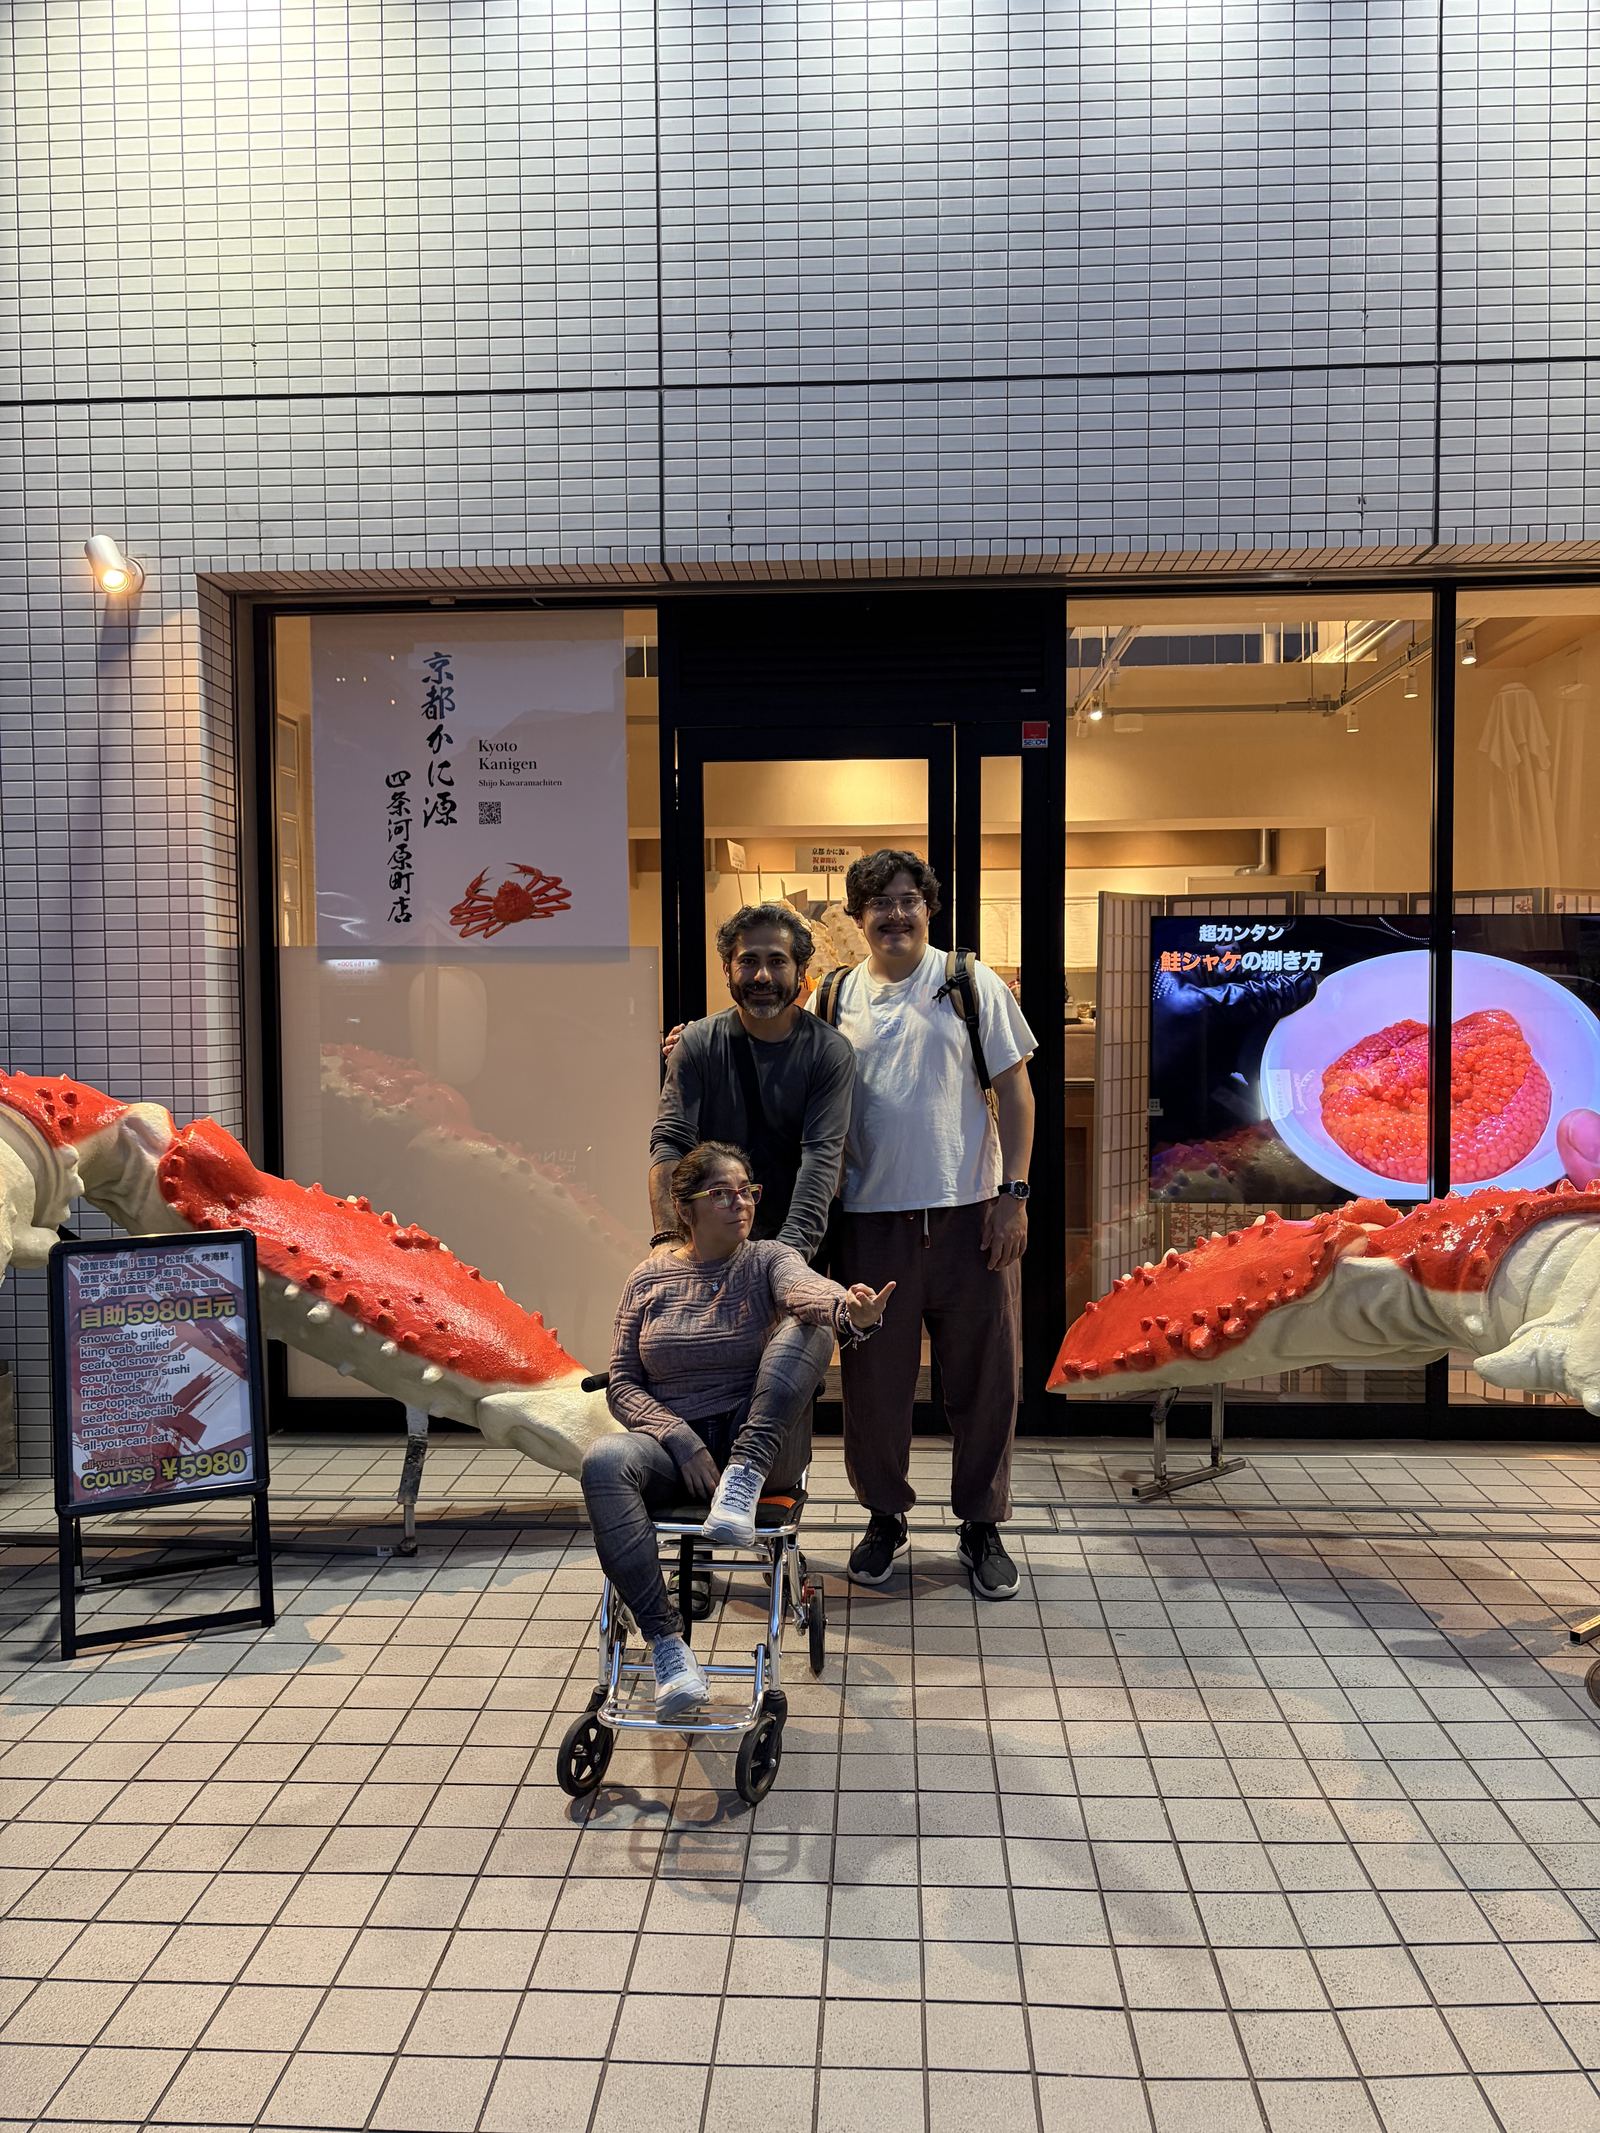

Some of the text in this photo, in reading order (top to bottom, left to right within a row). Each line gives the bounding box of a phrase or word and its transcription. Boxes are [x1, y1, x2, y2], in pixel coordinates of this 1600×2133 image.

[421, 651, 458, 829] 京都かに源
[478, 740, 518, 756] Kyoto
[478, 757, 537, 774] Kanigen
[478, 779, 563, 788] Shijo Kawaramachiten
[385, 770, 414, 923] 四条河原町店
[1199, 924, 1284, 943] 超カンタン
[1160, 950, 1323, 972] 鮭シャケの捌き方
[81, 1296, 236, 1328] 自助5980日元
[81, 1327, 175, 1344] snow crab grilled
[81, 1340, 169, 1357] king crab grilled
[81, 1352, 185, 1371] seafood snow crab
[81, 1364, 190, 1385] soup tempura sushi
[81, 1383, 141, 1397] fried foods
[82, 1393, 172, 1410] rice topped with
[82, 1405, 182, 1424] seafood specially-
[82, 1423, 148, 1438] made curry
[83, 1433, 169, 1452] all-you-can-eat
[82, 1449, 247, 1489] course ¥5980
